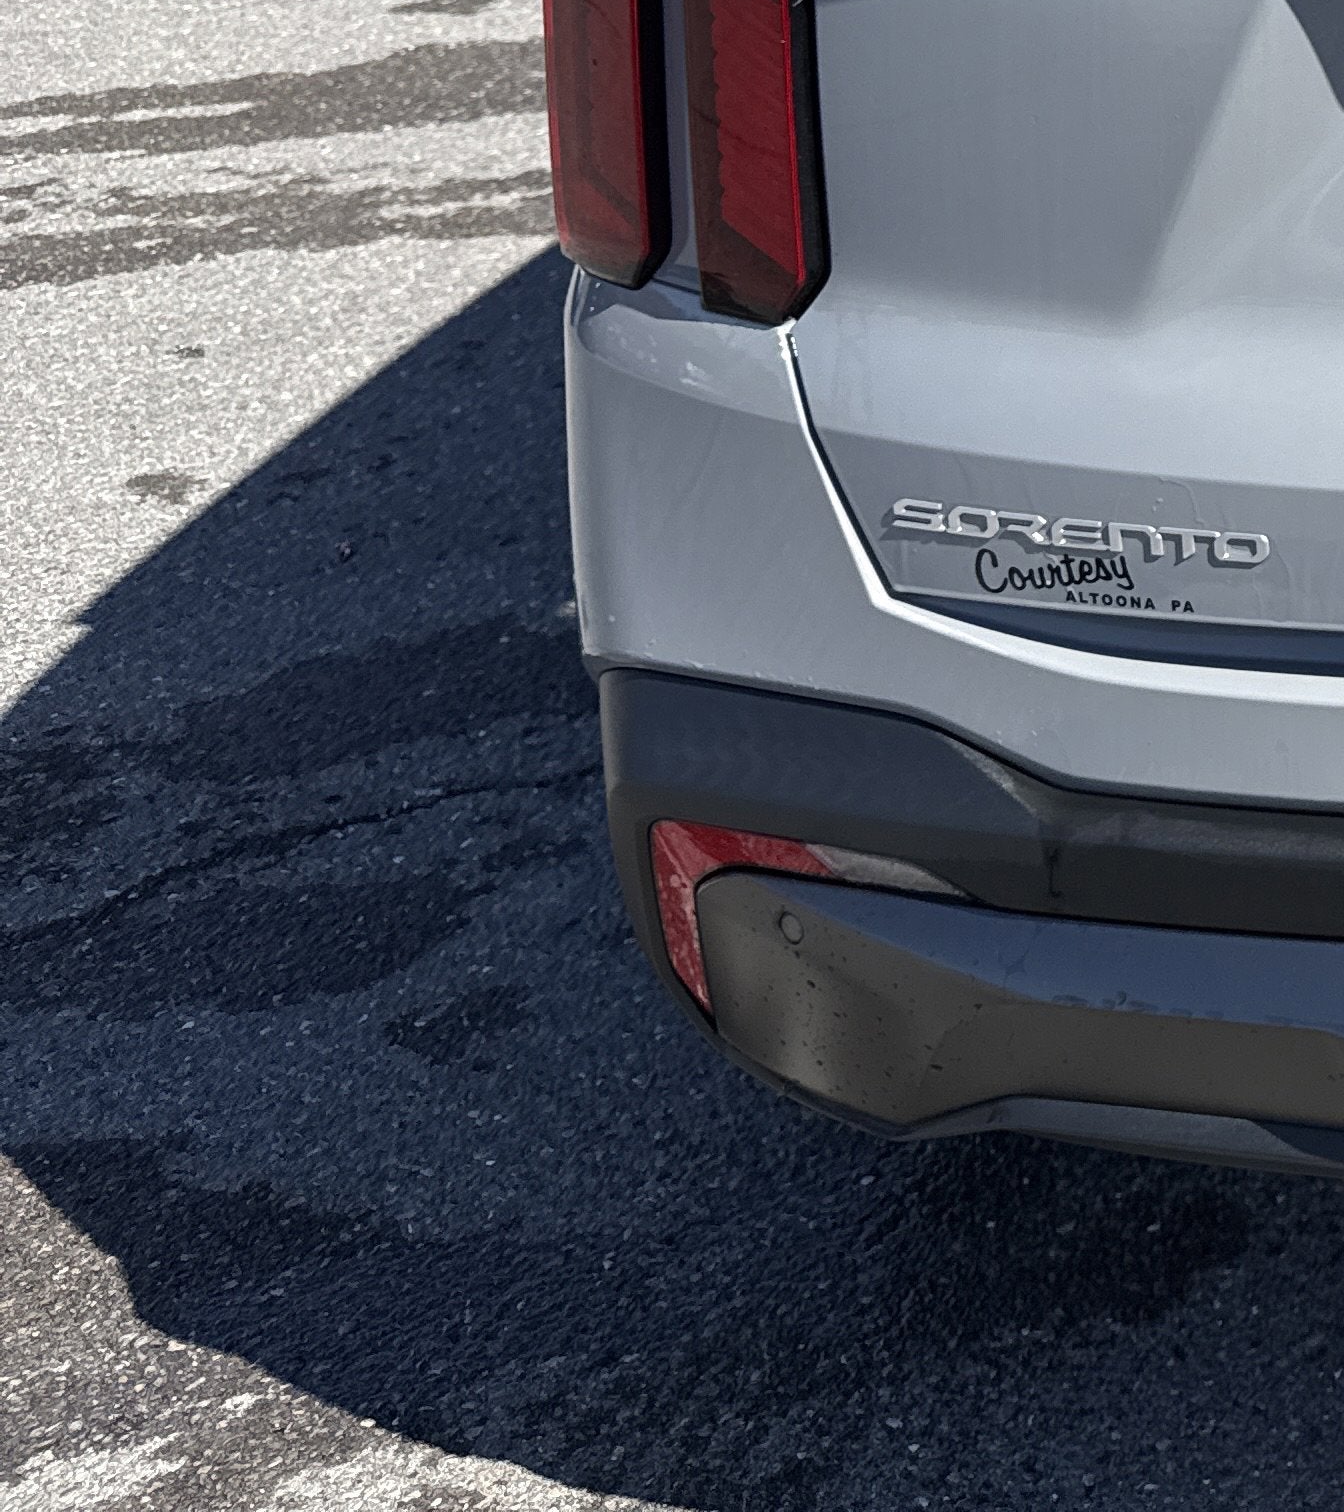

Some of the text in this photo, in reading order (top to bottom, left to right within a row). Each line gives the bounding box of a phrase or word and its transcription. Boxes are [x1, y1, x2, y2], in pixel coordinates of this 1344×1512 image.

[892, 497, 1270, 564] SORENTO
[975, 548, 1136, 594] Courtesy
[1064, 589, 1196, 614] ALTOONA PA
